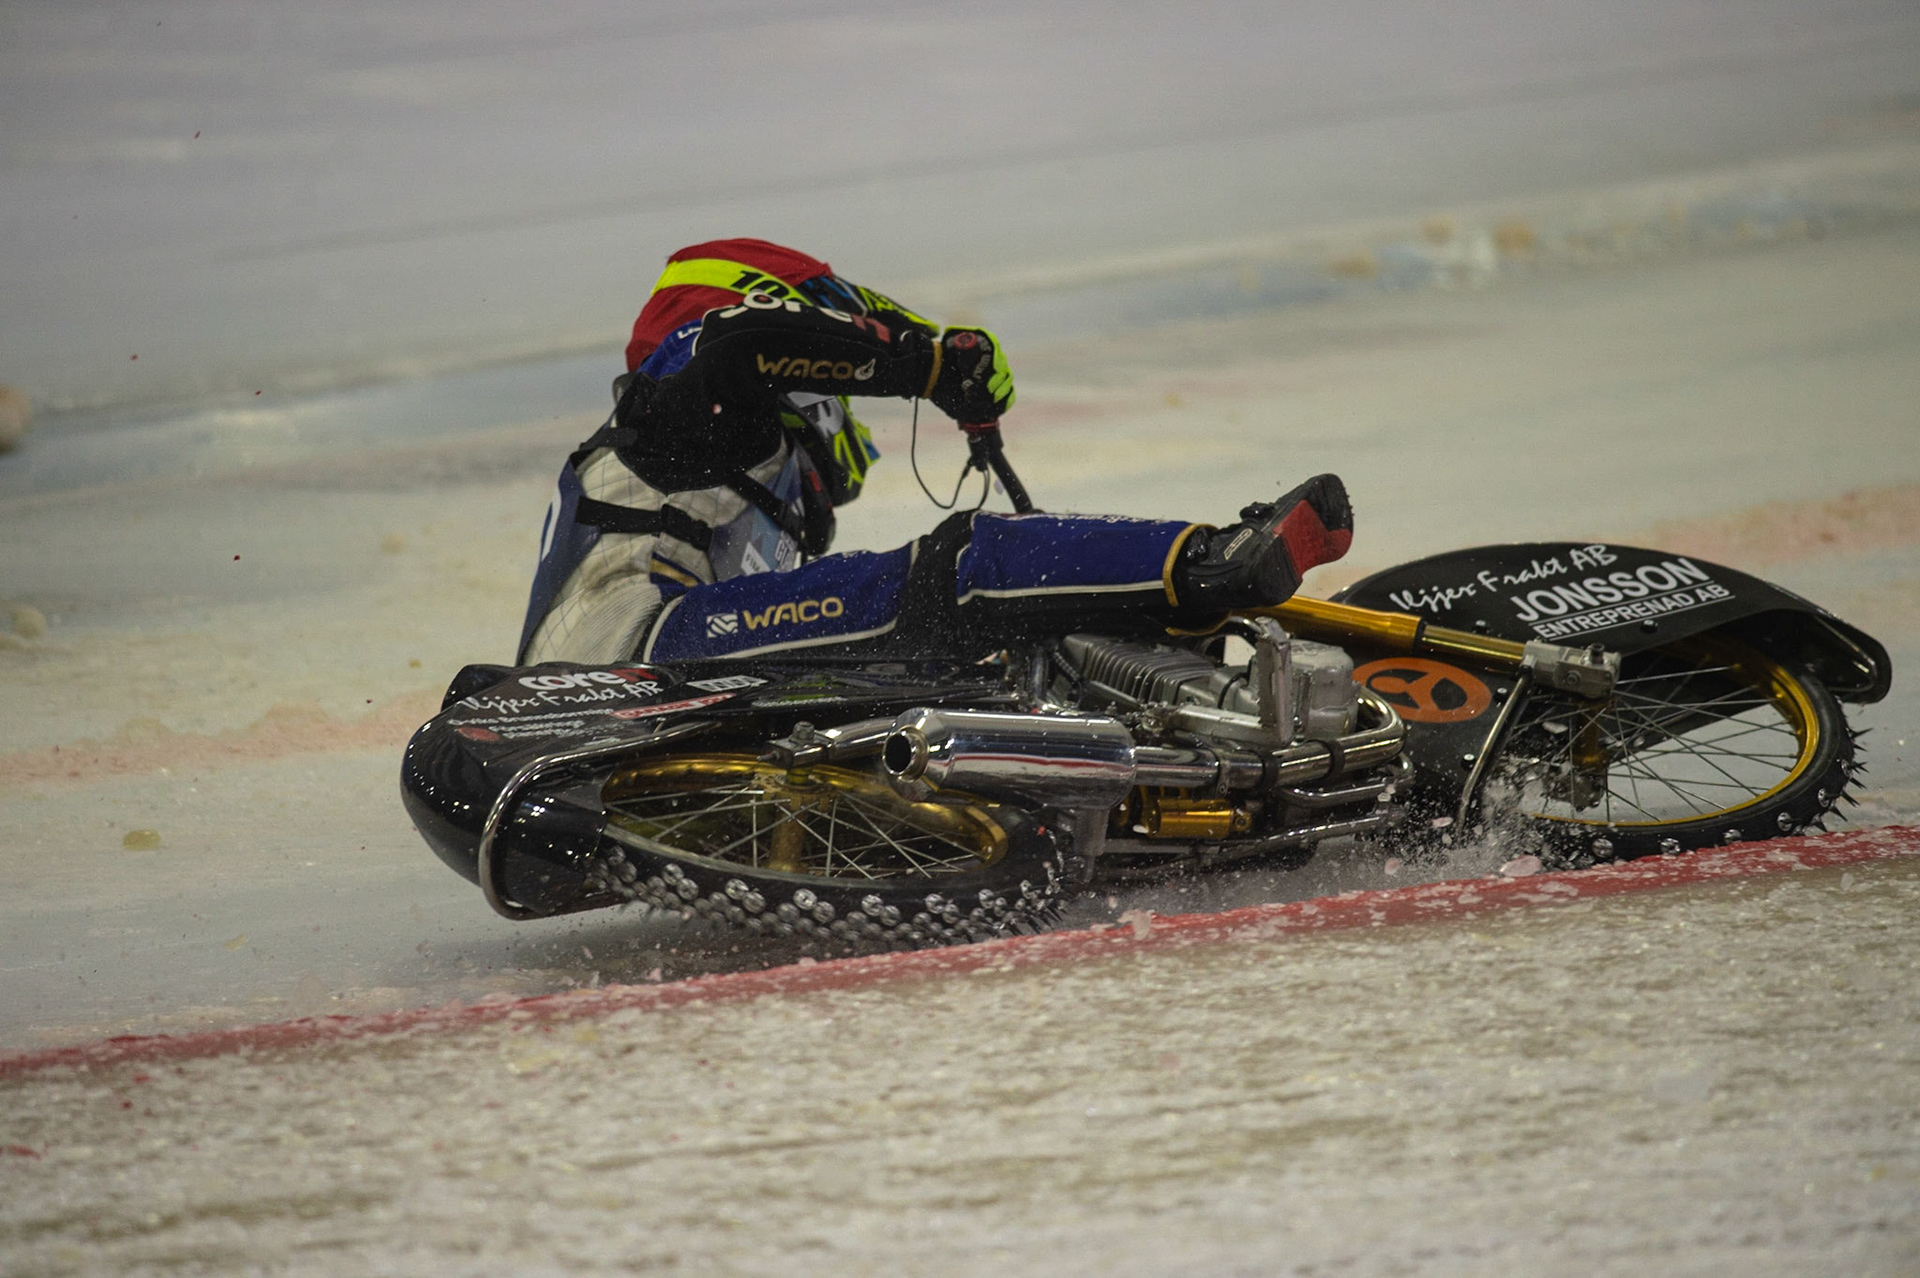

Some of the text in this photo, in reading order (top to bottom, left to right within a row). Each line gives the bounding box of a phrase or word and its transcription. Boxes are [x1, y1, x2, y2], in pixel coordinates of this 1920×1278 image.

[757, 353, 853, 380] WACO
[1569, 544, 1618, 572] AB
[1510, 557, 1710, 622] JONSSON
[742, 597, 844, 631] WACO
[1533, 583, 1731, 640] ENTREPRENAD AB
